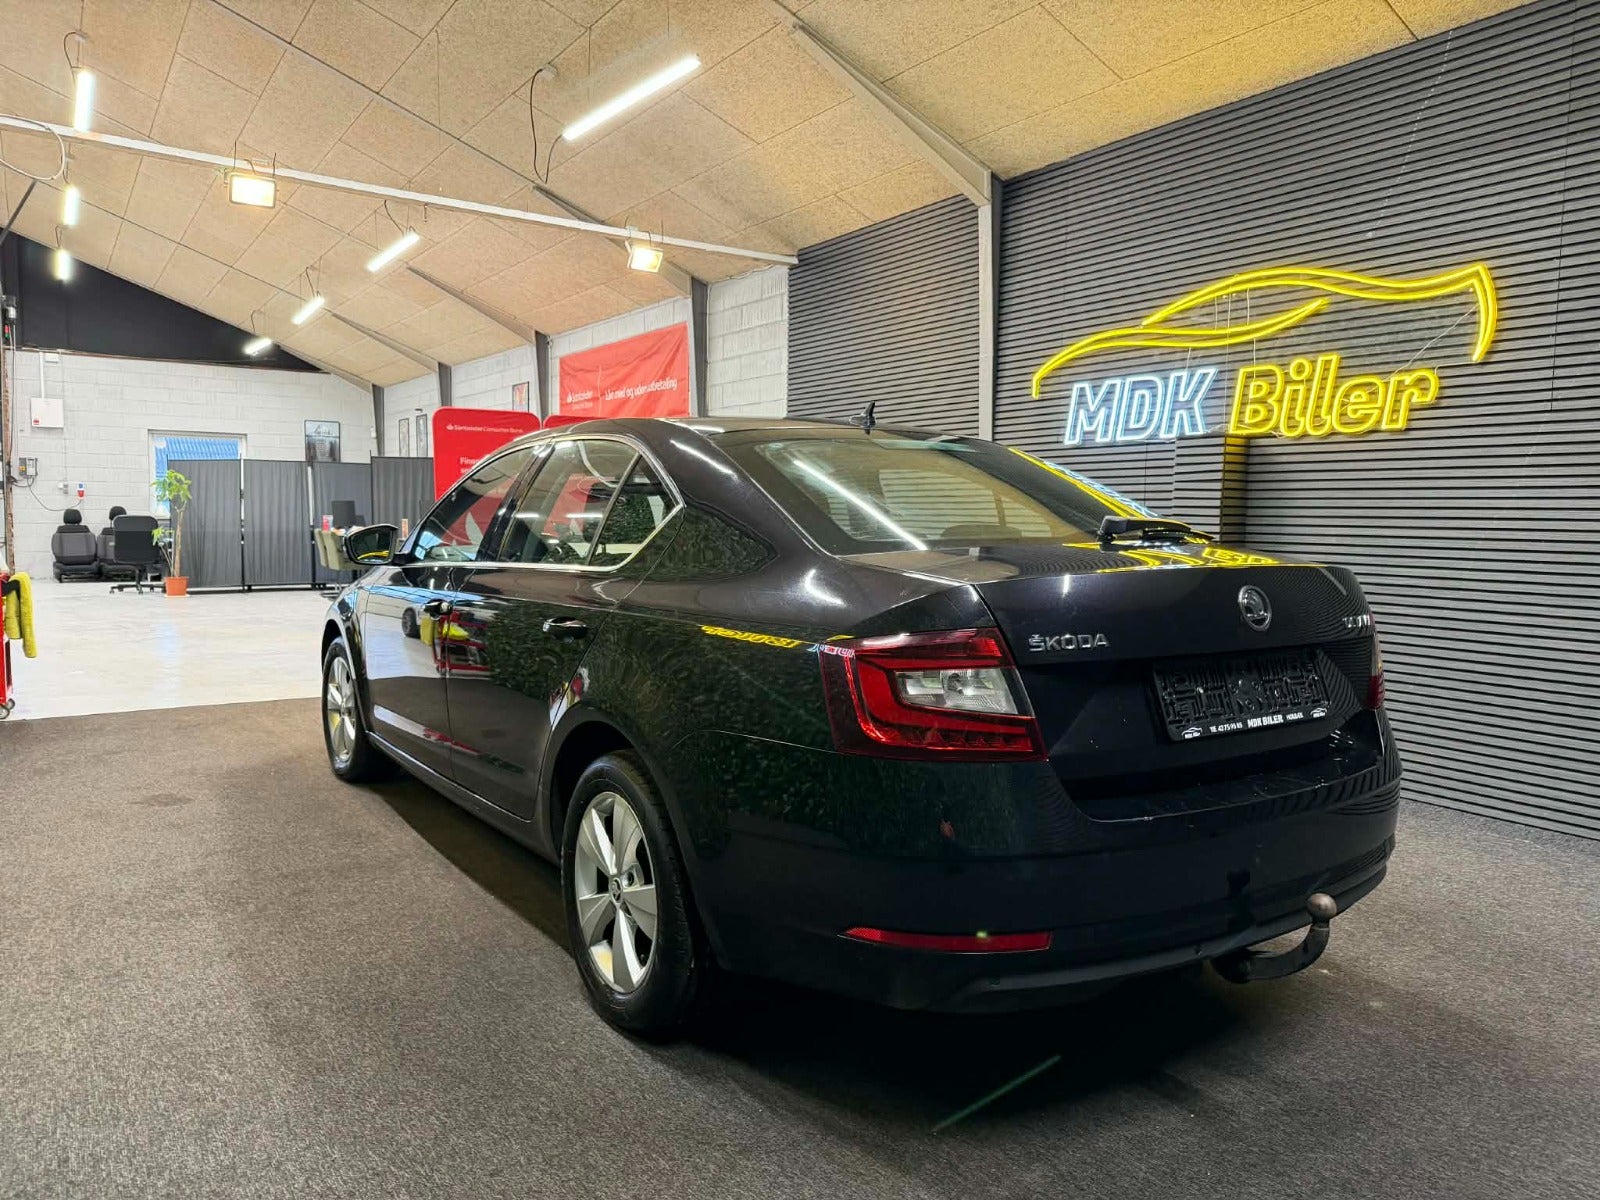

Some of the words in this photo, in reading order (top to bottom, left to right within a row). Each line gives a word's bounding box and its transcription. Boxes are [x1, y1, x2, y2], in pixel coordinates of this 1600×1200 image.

[1064, 366, 1219, 445] MDK
[1229, 352, 1440, 437] Biler
[1028, 634, 1109, 651] ŠKODA
[1262, 714, 1284, 726] BILER
